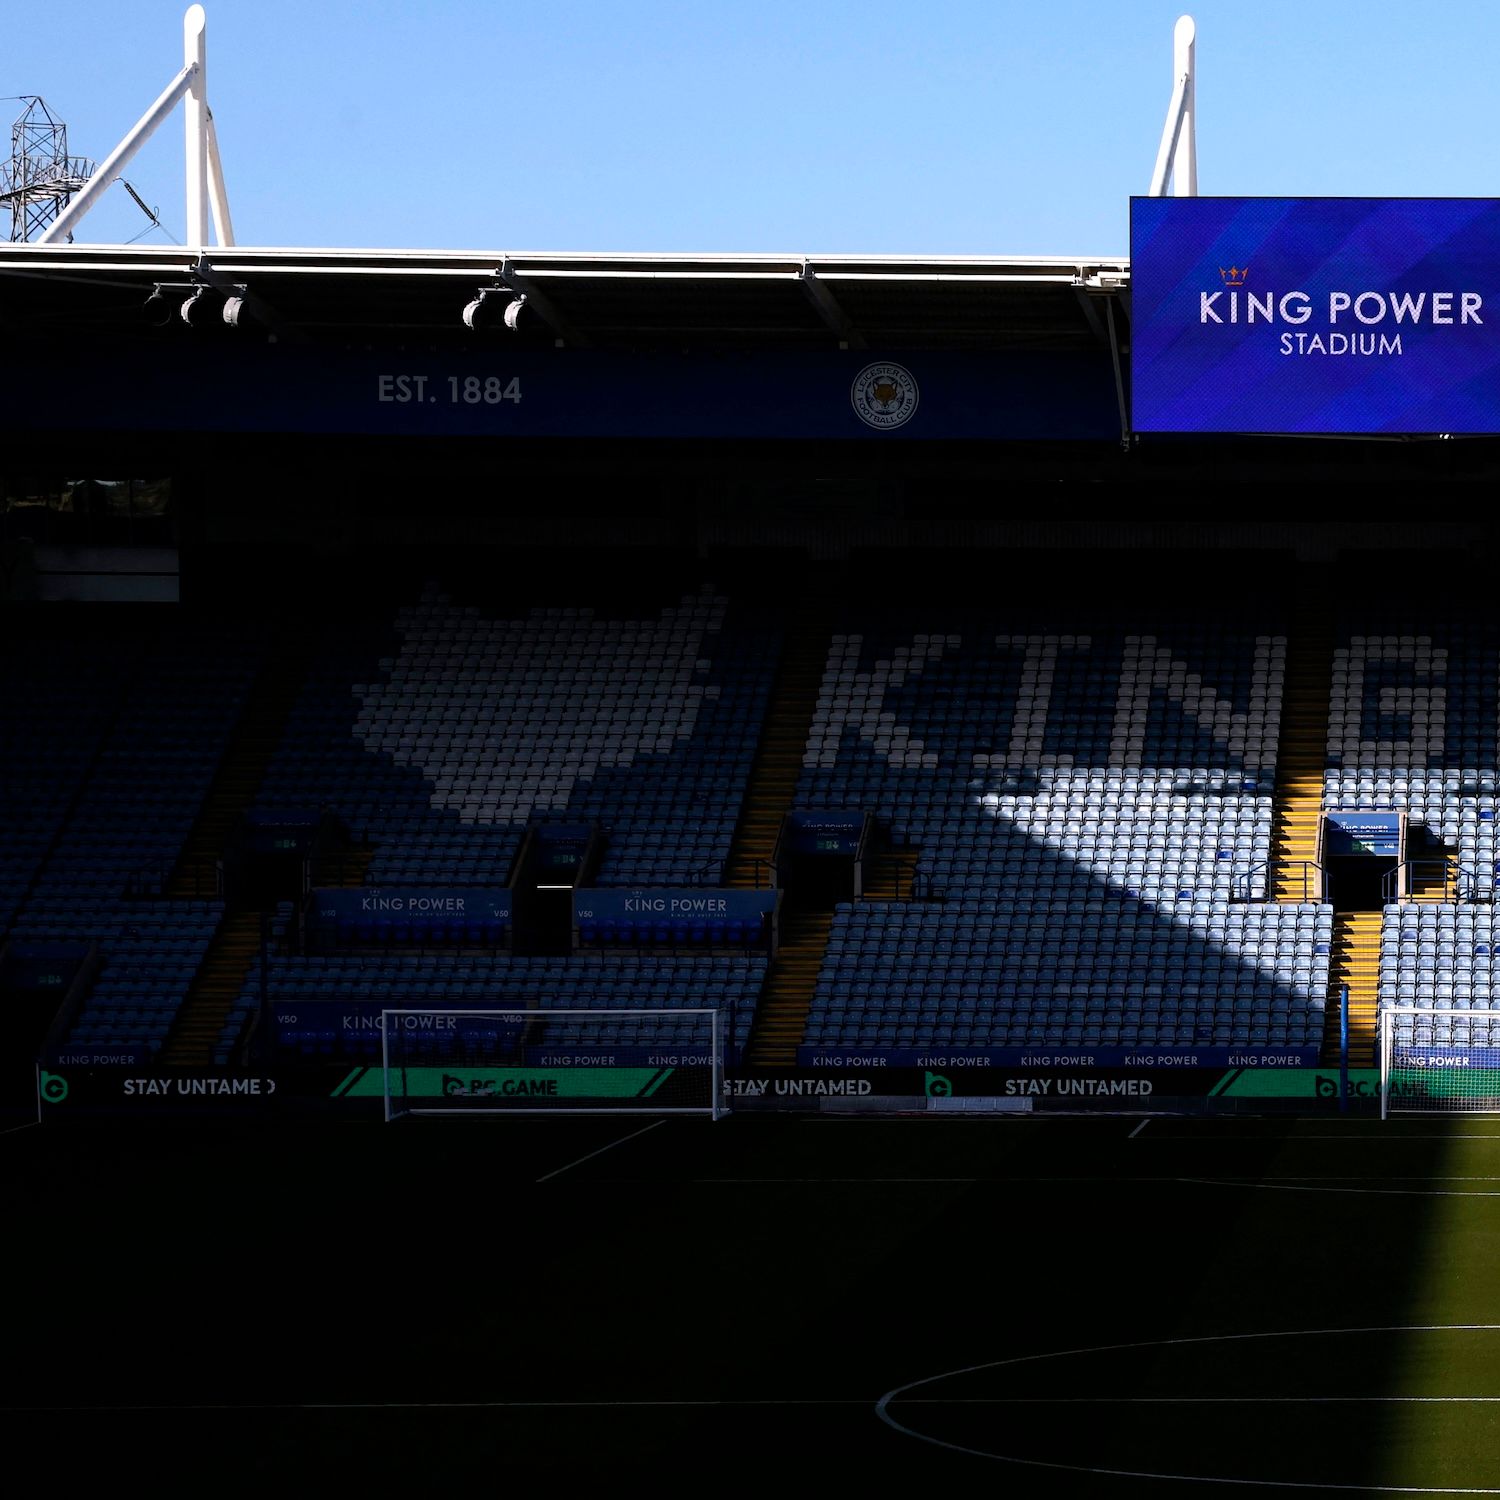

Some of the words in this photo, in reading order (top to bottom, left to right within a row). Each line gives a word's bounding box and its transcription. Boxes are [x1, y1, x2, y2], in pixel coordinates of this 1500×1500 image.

[1200, 291, 1312, 324] KING
[1329, 291, 1484, 325] POWER
[1279, 332, 1402, 356] STADIUM
[857, 368, 900, 393] LEICESTER
[900, 375, 913, 394] CITY
[378, 374, 437, 403] EST.
[448, 376, 522, 404] 1884
[857, 398, 897, 424] FOOTBALL
[896, 398, 913, 420] CLUB
[802, 634, 1447, 769] KING
[362, 898, 403, 911] KING
[409, 898, 465, 911] POWER
[624, 899, 665, 911] KING
[671, 899, 726, 911] POWER
[494, 910, 509, 918] V50
[578, 910, 594, 918] V50
[277, 1015, 298, 1024] V50
[343, 1016, 383, 1029] KING
[58, 1056, 91, 1064] KING
[94, 1056, 135, 1064] POWER
[541, 1056, 571, 1065] KING
[574, 1056, 615, 1065] POWER
[648, 1056, 678, 1065] KING
[813, 1056, 843, 1066] KING
[846, 1056, 887, 1066] POWER
[917, 1056, 946, 1066] KING
[950, 1056, 991, 1066] POWER
[1021, 1056, 1051, 1066] KING
[1054, 1056, 1094, 1066] POWER
[1125, 1056, 1155, 1065] KING
[1158, 1056, 1198, 1065] POWER
[1228, 1056, 1257, 1065] KING
[1261, 1056, 1301, 1065] POWER
[1429, 1057, 1469, 1066] POWER
[123, 1079, 172, 1095] STAY
[723, 1080, 770, 1095] STAY
[775, 1080, 871, 1095] UNTAMED
[1005, 1080, 1052, 1095] STAY
[1057, 1080, 1152, 1095] UNTAMED
